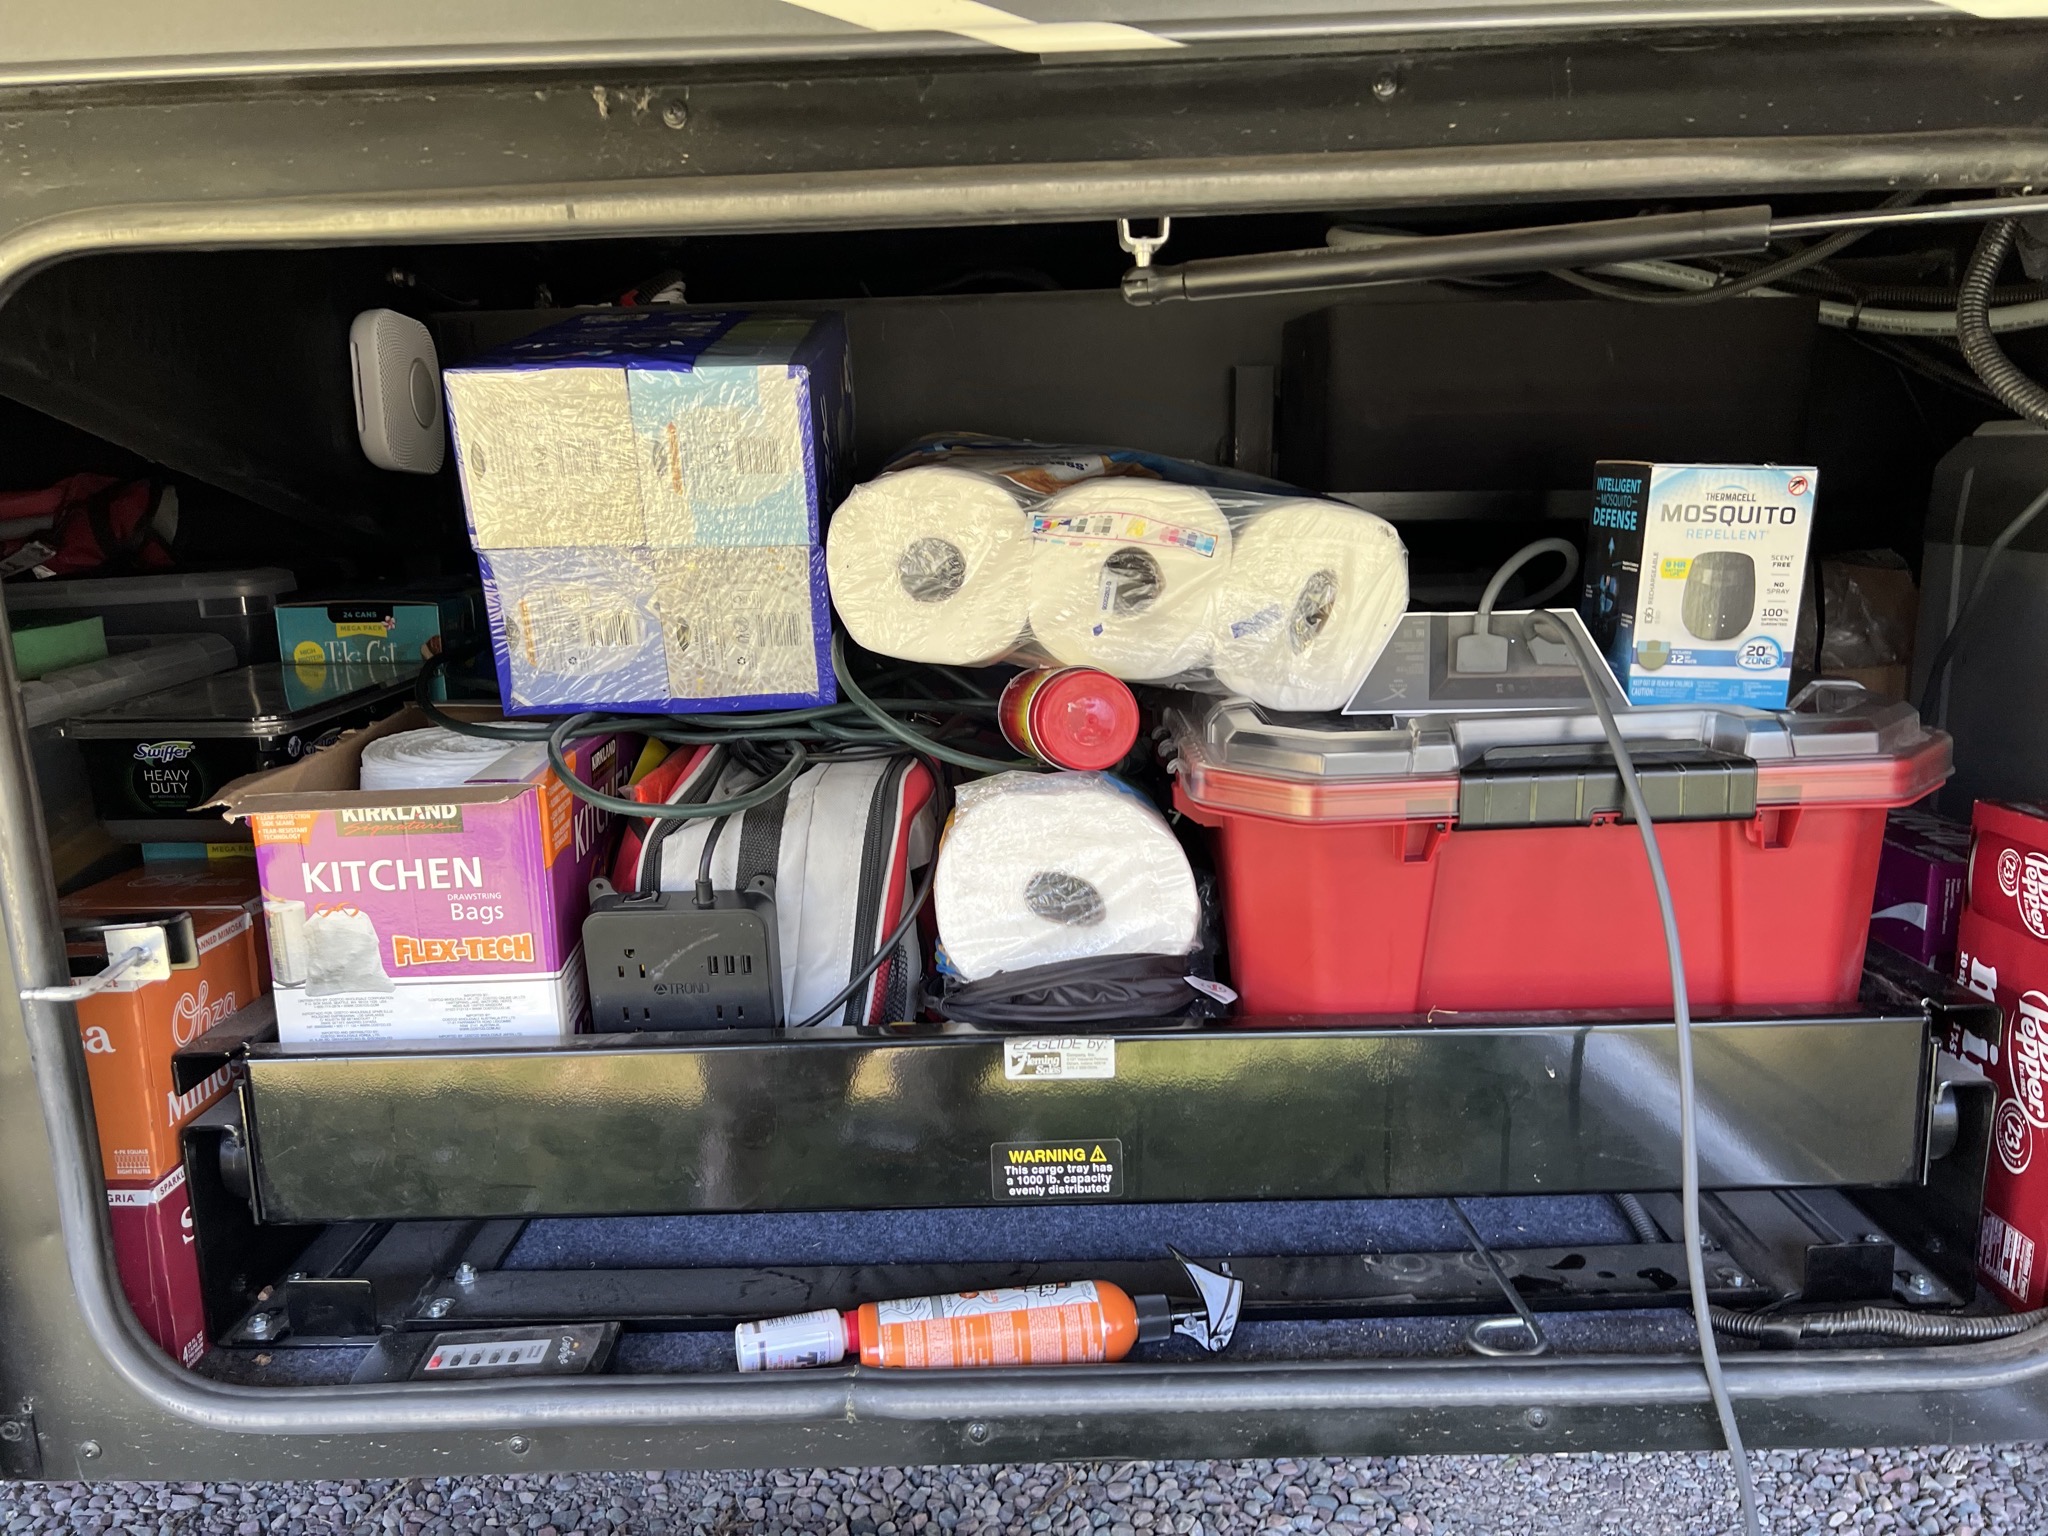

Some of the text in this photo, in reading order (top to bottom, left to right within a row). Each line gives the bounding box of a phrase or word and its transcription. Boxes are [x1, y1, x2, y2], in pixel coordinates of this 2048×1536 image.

[1597, 477, 1642, 493] INTELLIGENT
[1600, 493, 1632, 507] MOSQUITO
[1706, 493, 1756, 502] THERMACELL
[1593, 507, 1637, 531] DEFENSE
[1661, 504, 1796, 526] MOSQUITO
[1686, 528, 1766, 540] REPELLENT
[1648, 552, 1658, 604] RECHARGEABLE
[1671, 655, 1683, 663] 12
[1746, 646, 1765, 656] 20
[1745, 655, 1771, 664] ZONE
[134, 742, 191, 762] Swiffer
[591, 739, 616, 772] KIRKLAND
[144, 770, 190, 781] HEAVY
[151, 783, 188, 794] DUTY
[341, 805, 457, 822] KIRKLAND
[344, 820, 458, 836] Signature
[302, 857, 482, 894] KITCHEN
[2004, 859, 2016, 879] 23
[447, 892, 502, 901] DRAWSTRING
[450, 903, 504, 925] Bags
[218, 923, 242, 941] MIMOSA
[392, 933, 534, 968] FLEX-TECH
[1961, 951, 1968, 968] 10
[669, 983, 710, 994] TROND
[173, 980, 237, 1048] Ohza
[1013, 1040, 1108, 1051] EZ-GLIDE by:
[1036, 1065, 1060, 1075] Sales
[167, 1058, 244, 1127] Mimos
[2004, 1120, 2022, 1150] 23
[1008, 1149, 1086, 1163] WARNING
[1004, 1163, 1113, 1177] This cargo tray has
[1017, 1176, 1043, 1185] 1000
[1046, 1175, 1060, 1184] lb.
[1064, 1173, 1112, 1186] capacity
[1009, 1183, 1110, 1196] evenly distributed
